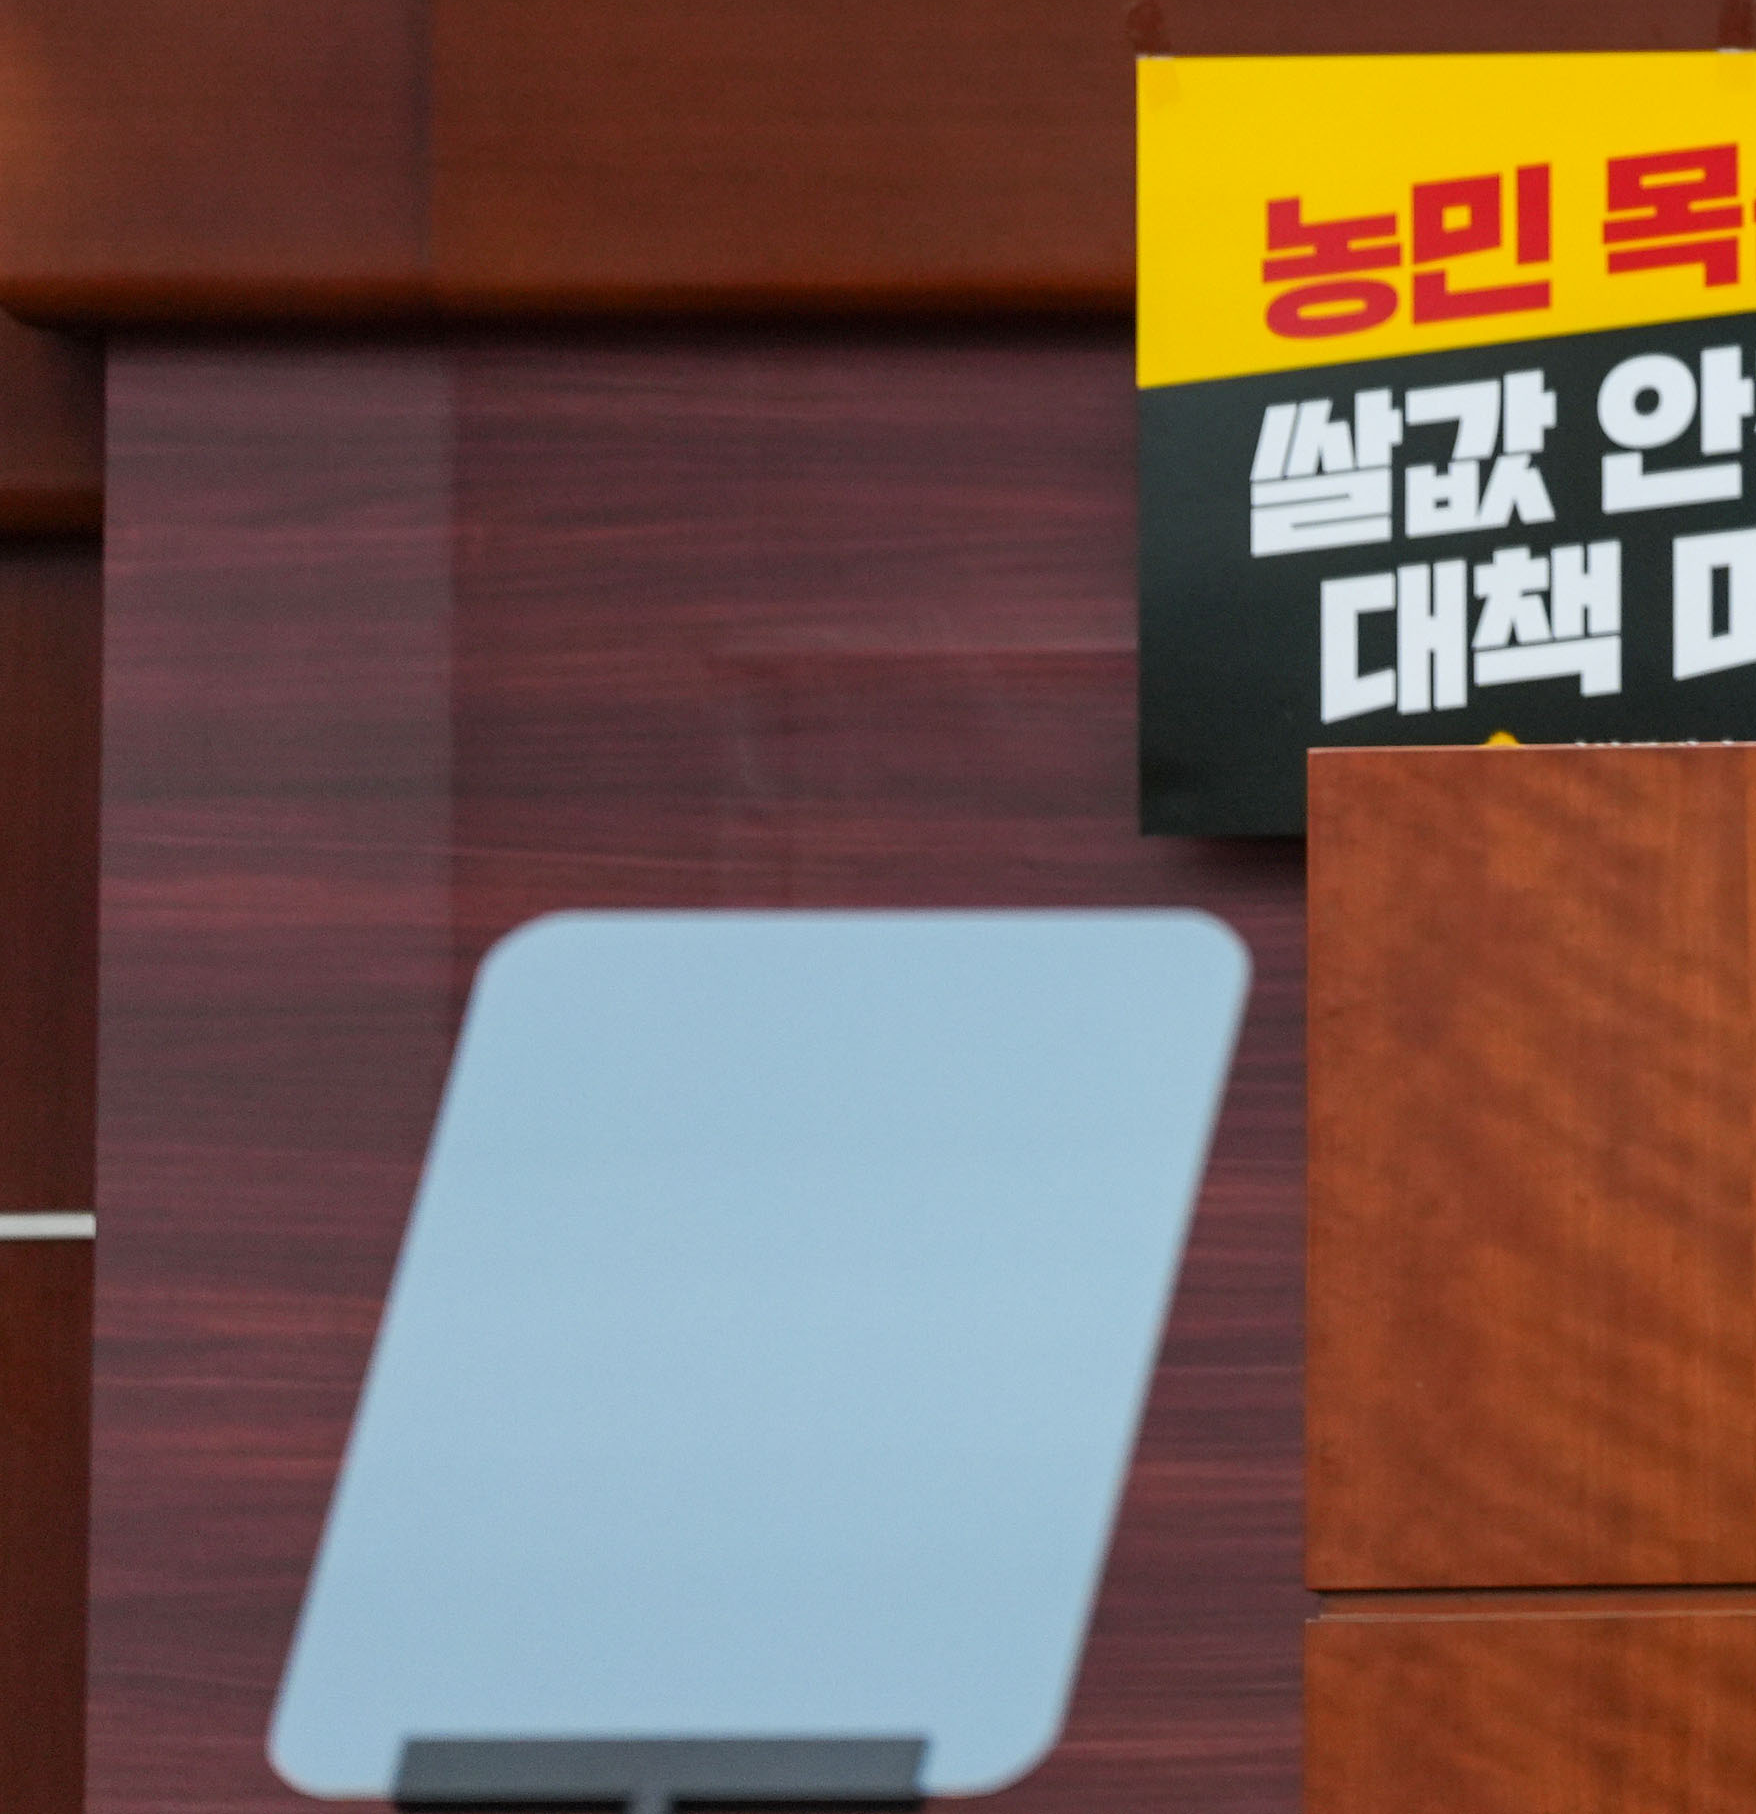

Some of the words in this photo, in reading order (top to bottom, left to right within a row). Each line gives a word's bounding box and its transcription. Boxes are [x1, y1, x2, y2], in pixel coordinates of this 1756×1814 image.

[1262, 163, 1551, 339] 농민
[1250, 369, 1556, 557] 쌀값
[1320, 539, 1622, 724] 대책
